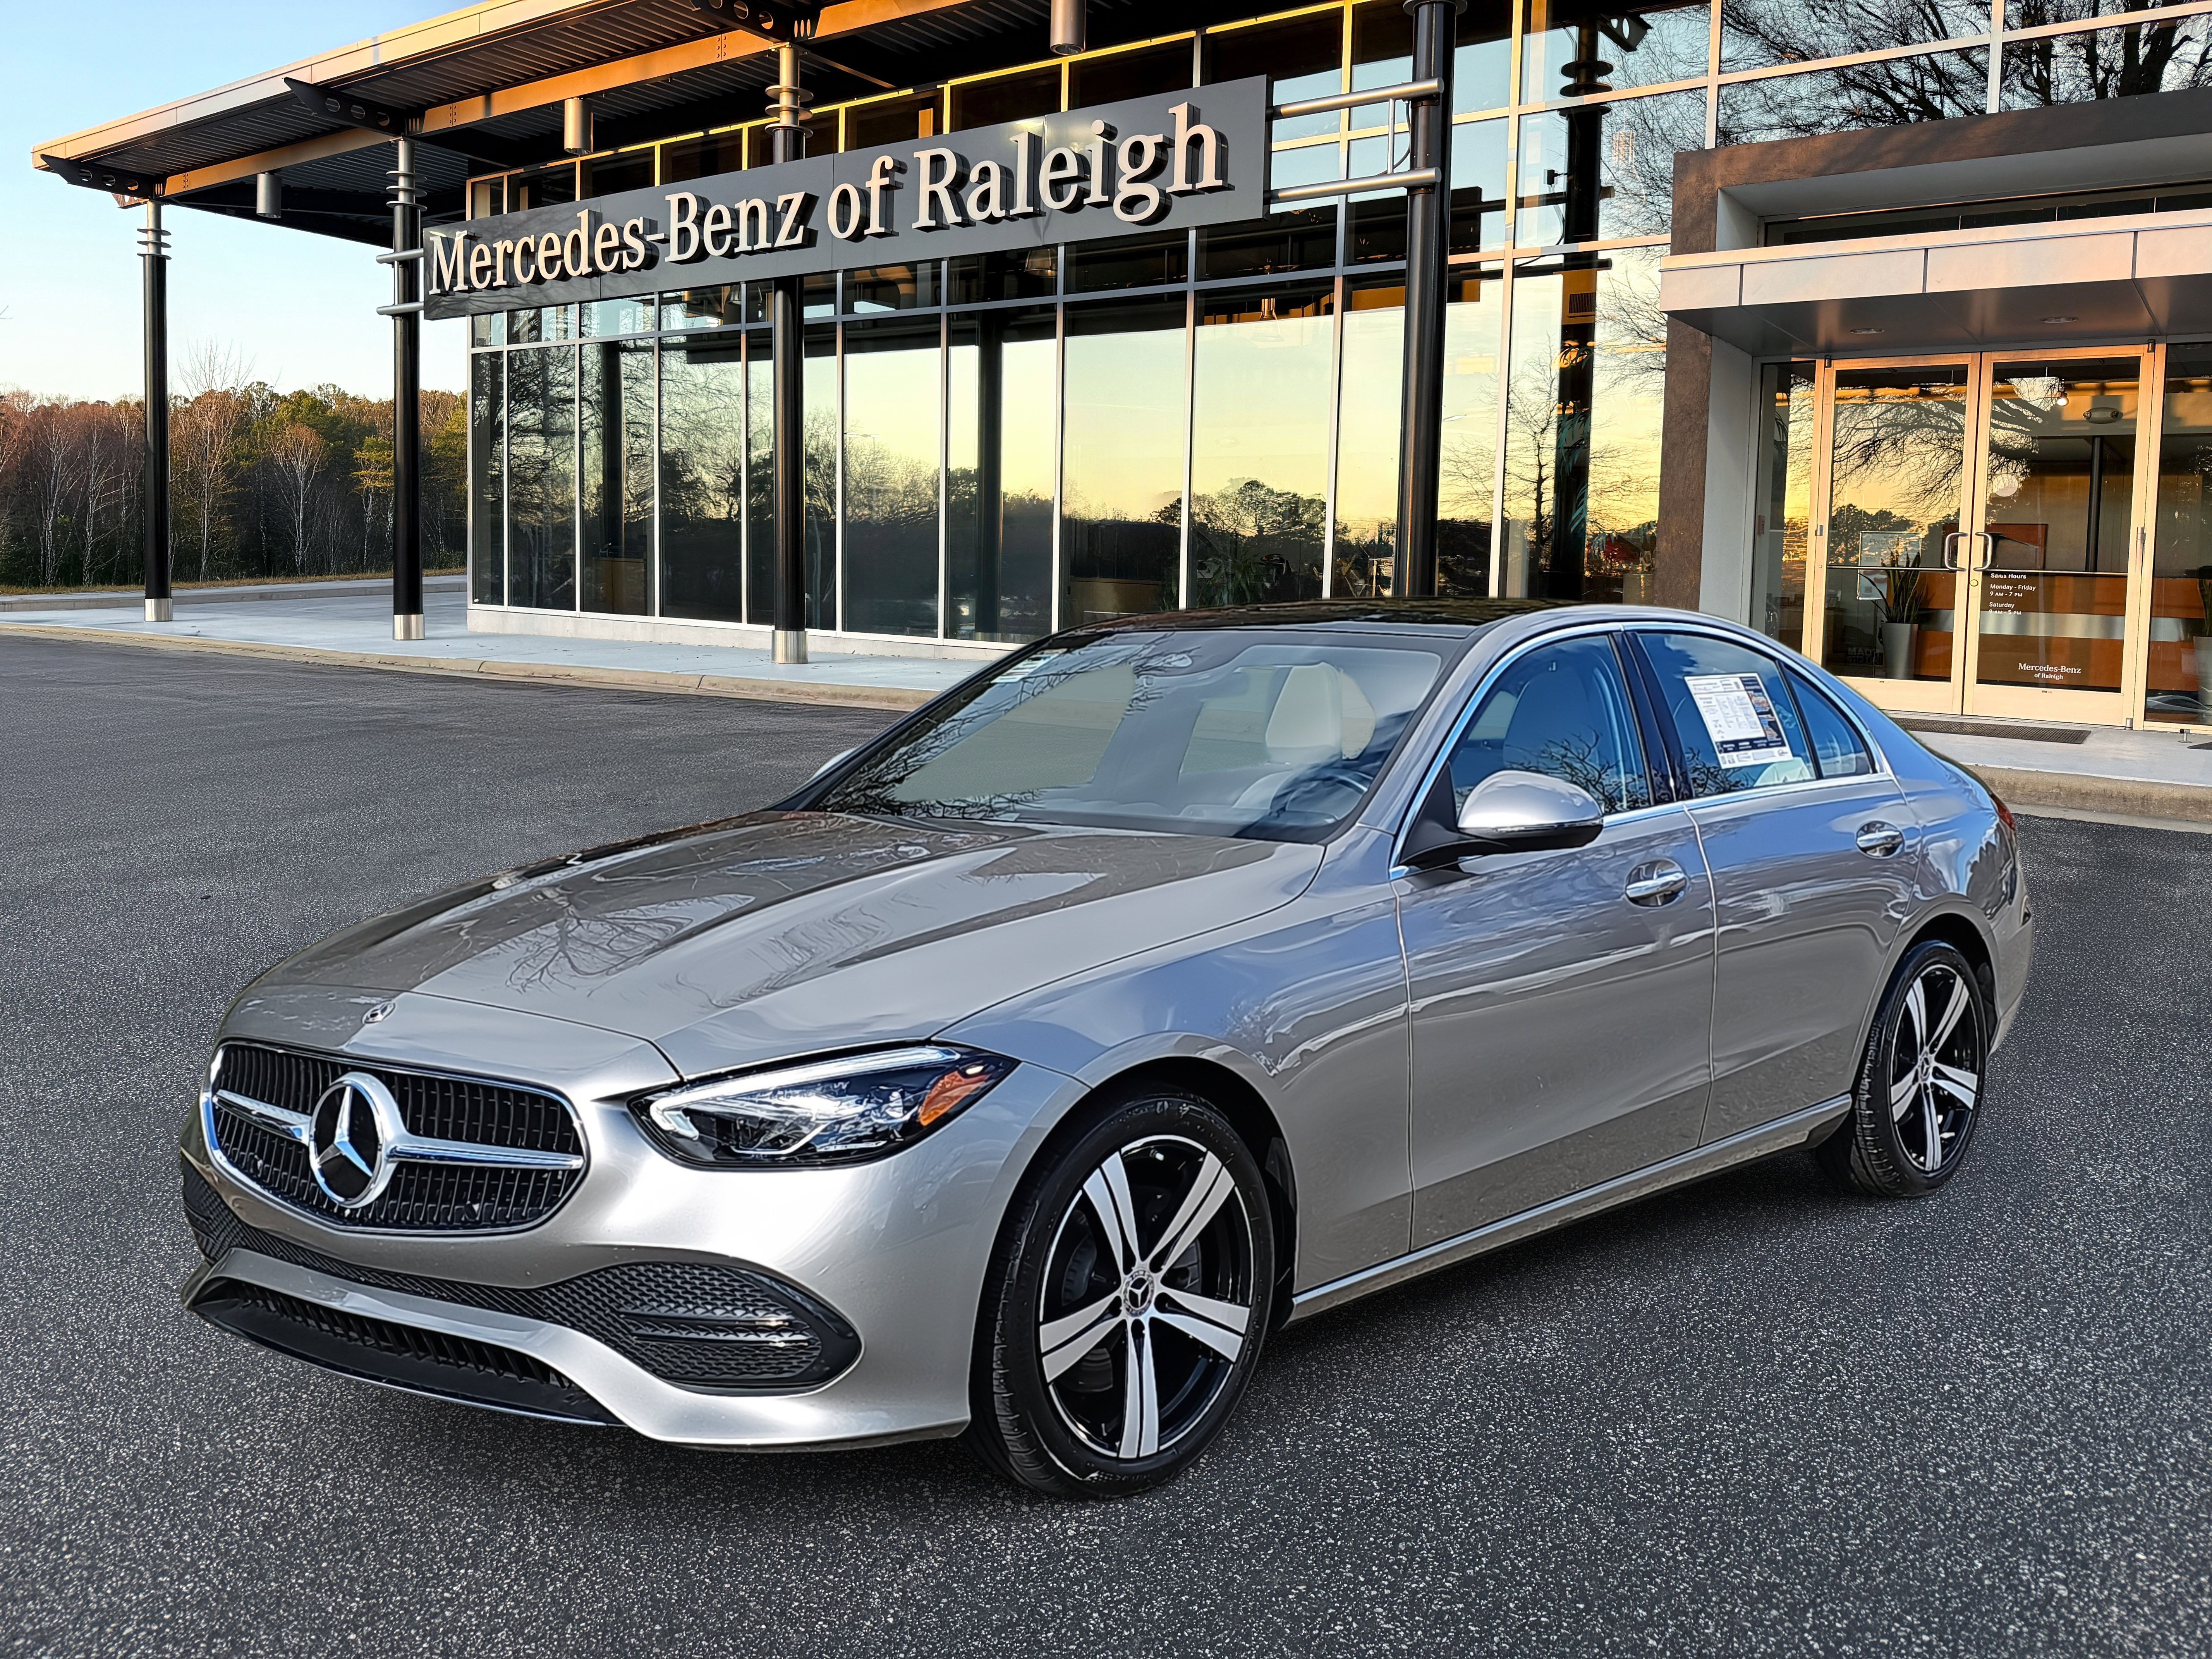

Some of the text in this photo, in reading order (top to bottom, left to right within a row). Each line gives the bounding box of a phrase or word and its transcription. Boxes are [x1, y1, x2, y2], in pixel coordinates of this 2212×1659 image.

[429, 101, 1224, 295] Mercedes-Benz of Raleigh
[2018, 663, 2081, 674] Mercedes-Benz
